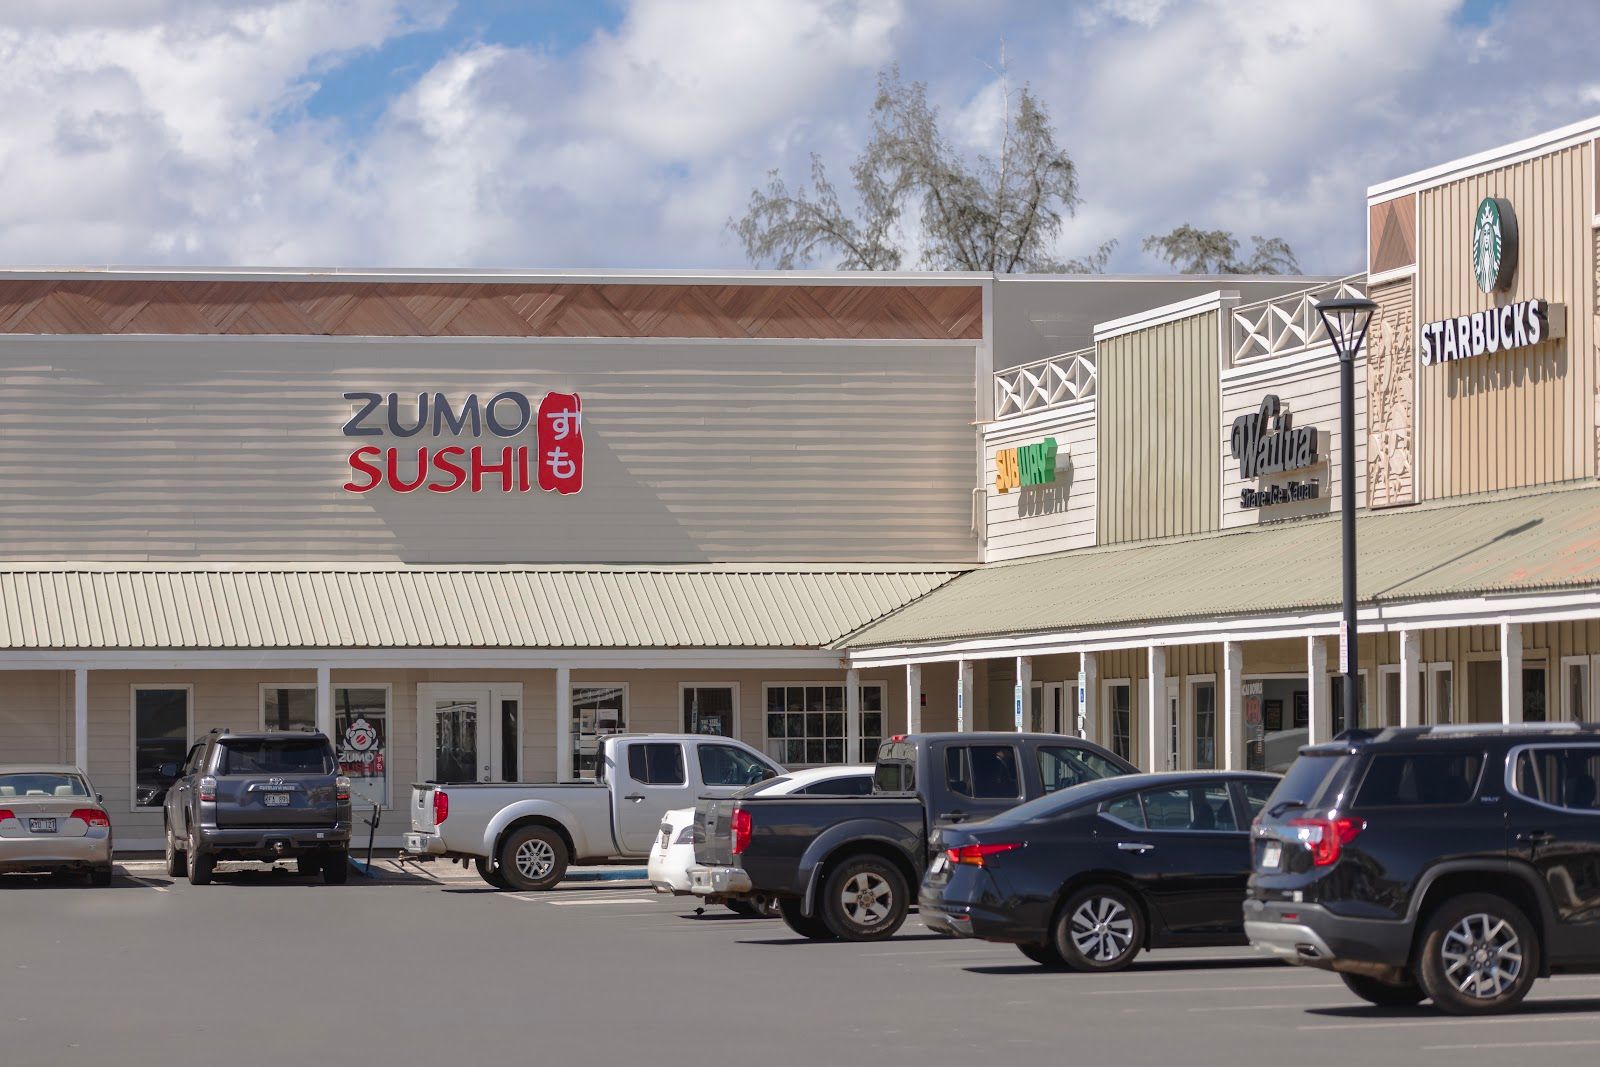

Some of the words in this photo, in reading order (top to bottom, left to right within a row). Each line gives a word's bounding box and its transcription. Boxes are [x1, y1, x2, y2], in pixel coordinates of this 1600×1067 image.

[1421, 299, 1544, 366] STARBUCKS
[343, 391, 531, 438] ZUMO
[1231, 394, 1317, 479] Wailua
[343, 445, 531, 493] SUSHI
[546, 407, 580, 479] すも
[996, 437, 1058, 493] SUBWAY
[1240, 488, 1269, 509] Shave
[339, 752, 374, 762] ZUMO
